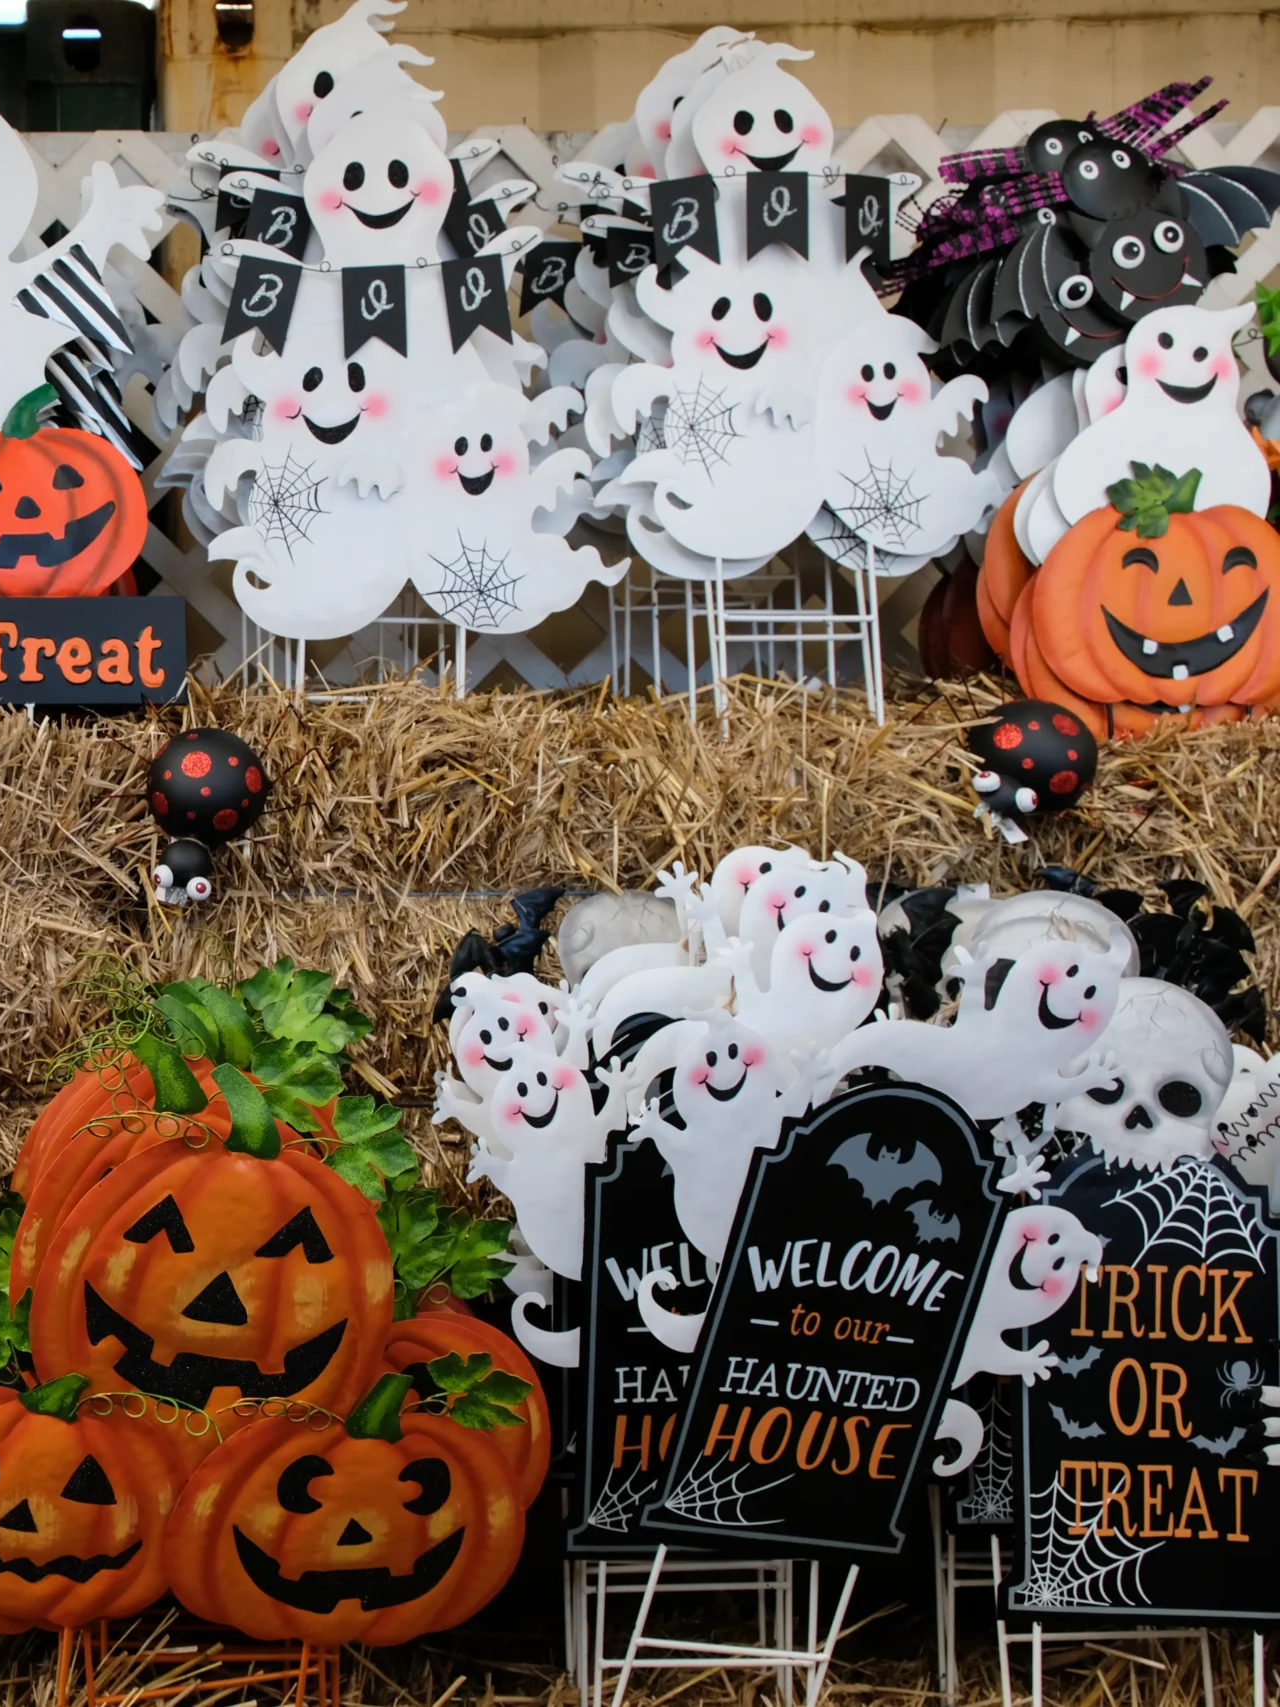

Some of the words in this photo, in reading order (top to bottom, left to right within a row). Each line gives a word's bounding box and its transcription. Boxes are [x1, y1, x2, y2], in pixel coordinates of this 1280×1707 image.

[747, 1238, 964, 1311] WELCOME
[1070, 1262, 1253, 1343] TRICK
[790, 1304, 821, 1336] to
[833, 1316, 890, 1344] our
[719, 1356, 921, 1412] HAUNTED
[1109, 1358, 1192, 1439] OR
[703, 1403, 913, 1479] HOUSE
[1059, 1460, 1259, 1542] TREAT
